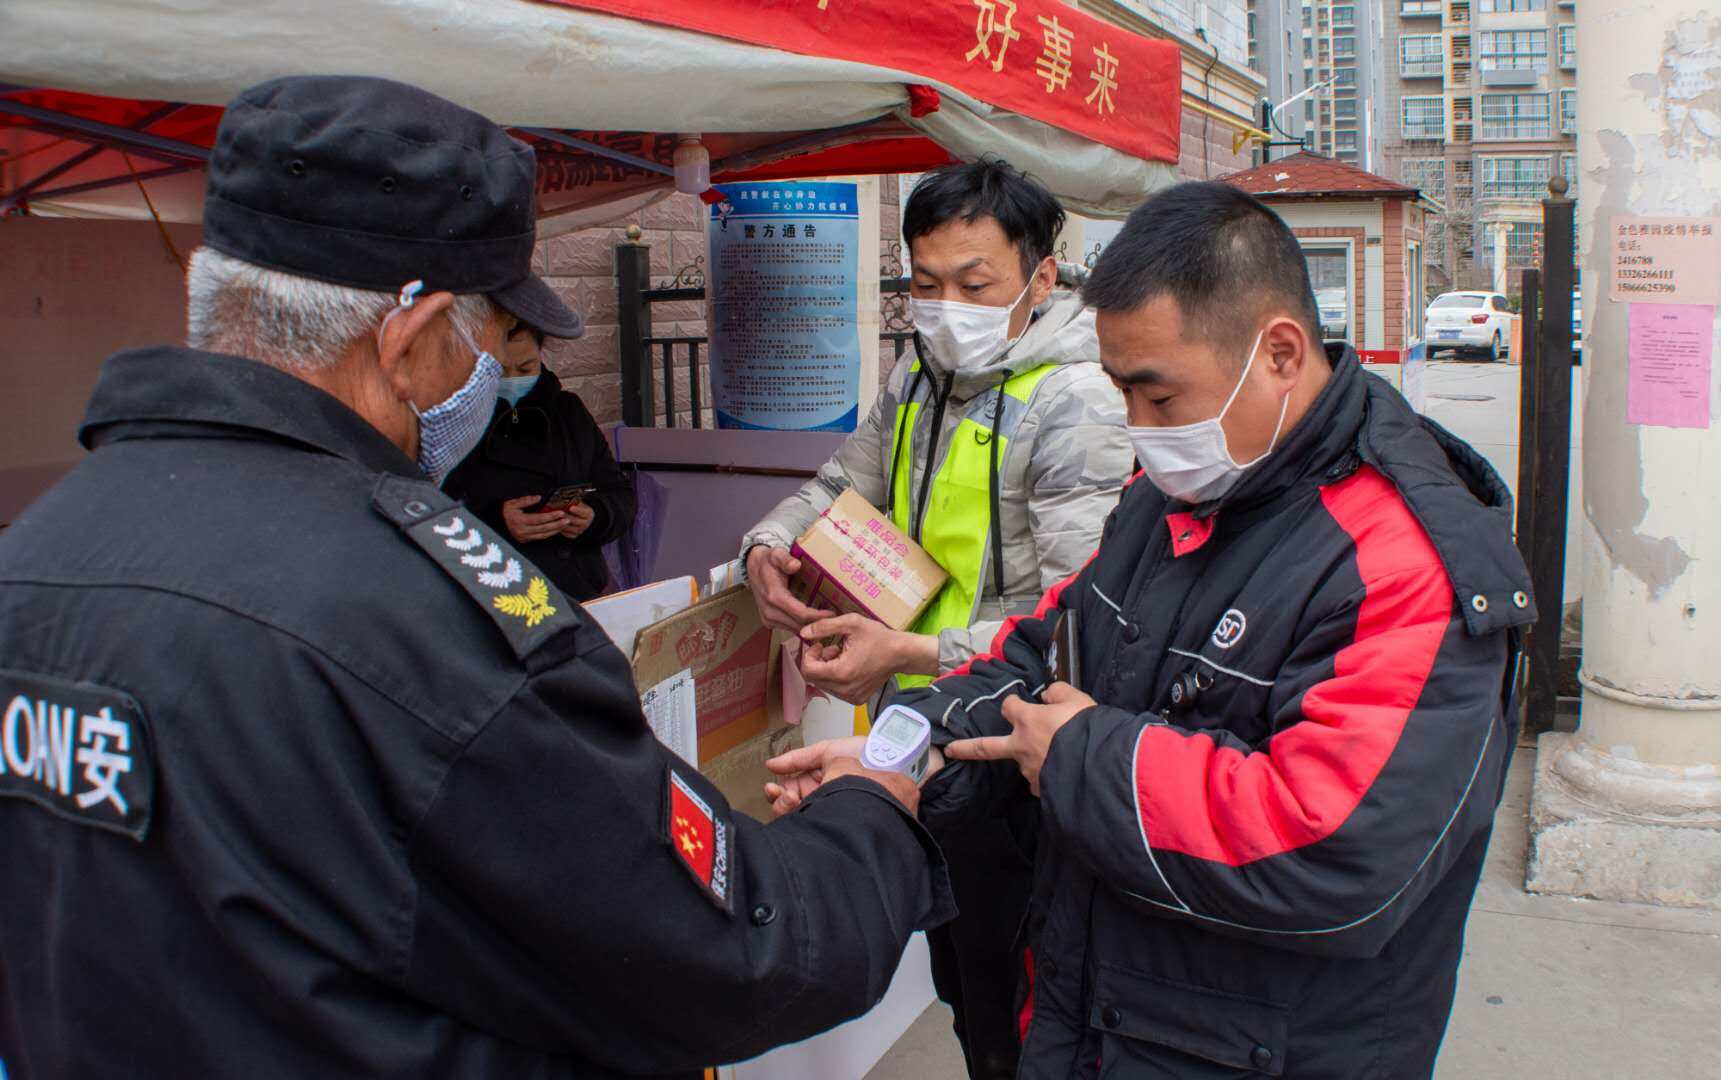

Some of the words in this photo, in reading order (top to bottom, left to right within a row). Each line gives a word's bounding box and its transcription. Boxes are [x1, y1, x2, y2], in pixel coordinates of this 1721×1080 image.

[965, 0, 1119, 114] 好事来
[744, 224, 817, 239] 警方通告
[867, 519, 909, 557] 唯品会
